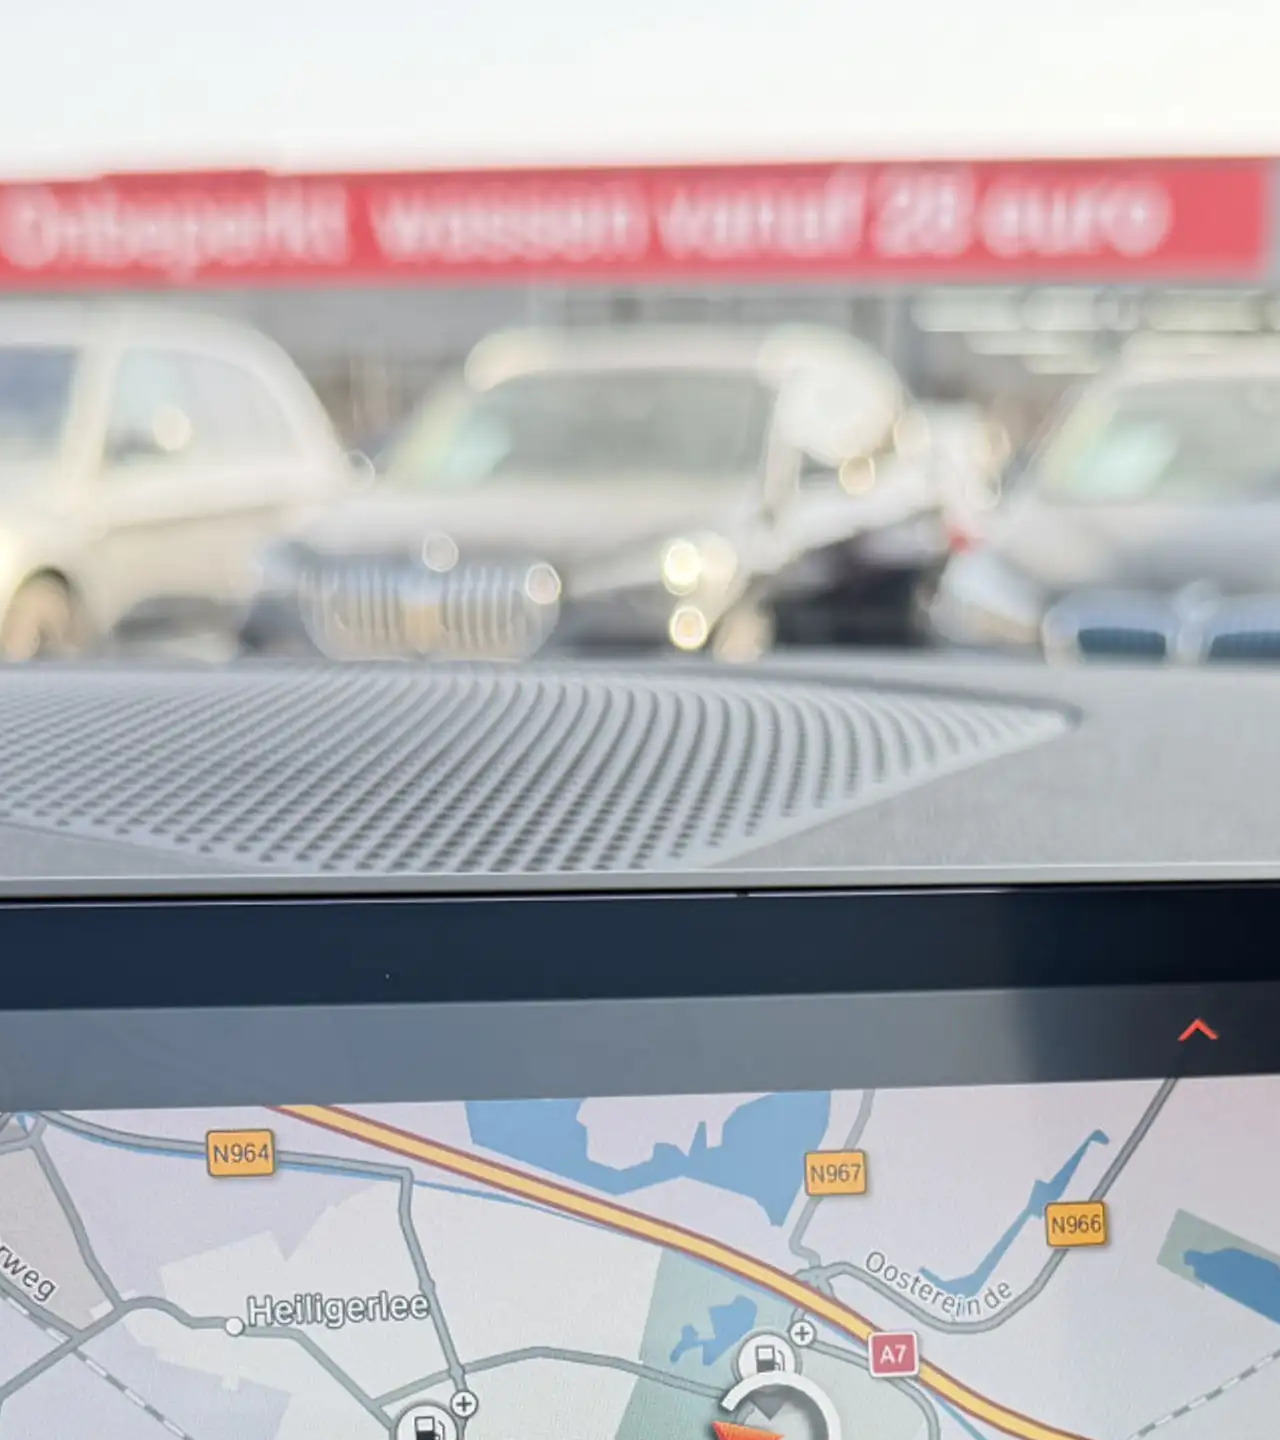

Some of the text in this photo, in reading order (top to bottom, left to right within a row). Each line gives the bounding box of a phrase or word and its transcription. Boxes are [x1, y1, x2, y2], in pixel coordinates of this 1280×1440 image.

[368, 186, 650, 266] wassen
[658, 168, 864, 260] vanaf
[978, 176, 1174, 258] euro
[212, 1142, 270, 1164] N964
[810, 1162, 862, 1185] N967
[1051, 1213, 1102, 1236] N966
[864, 1250, 1014, 1318] Oostereinde
[246, 1291, 431, 1331] Heiligerlee
[879, 1344, 908, 1365] A7
